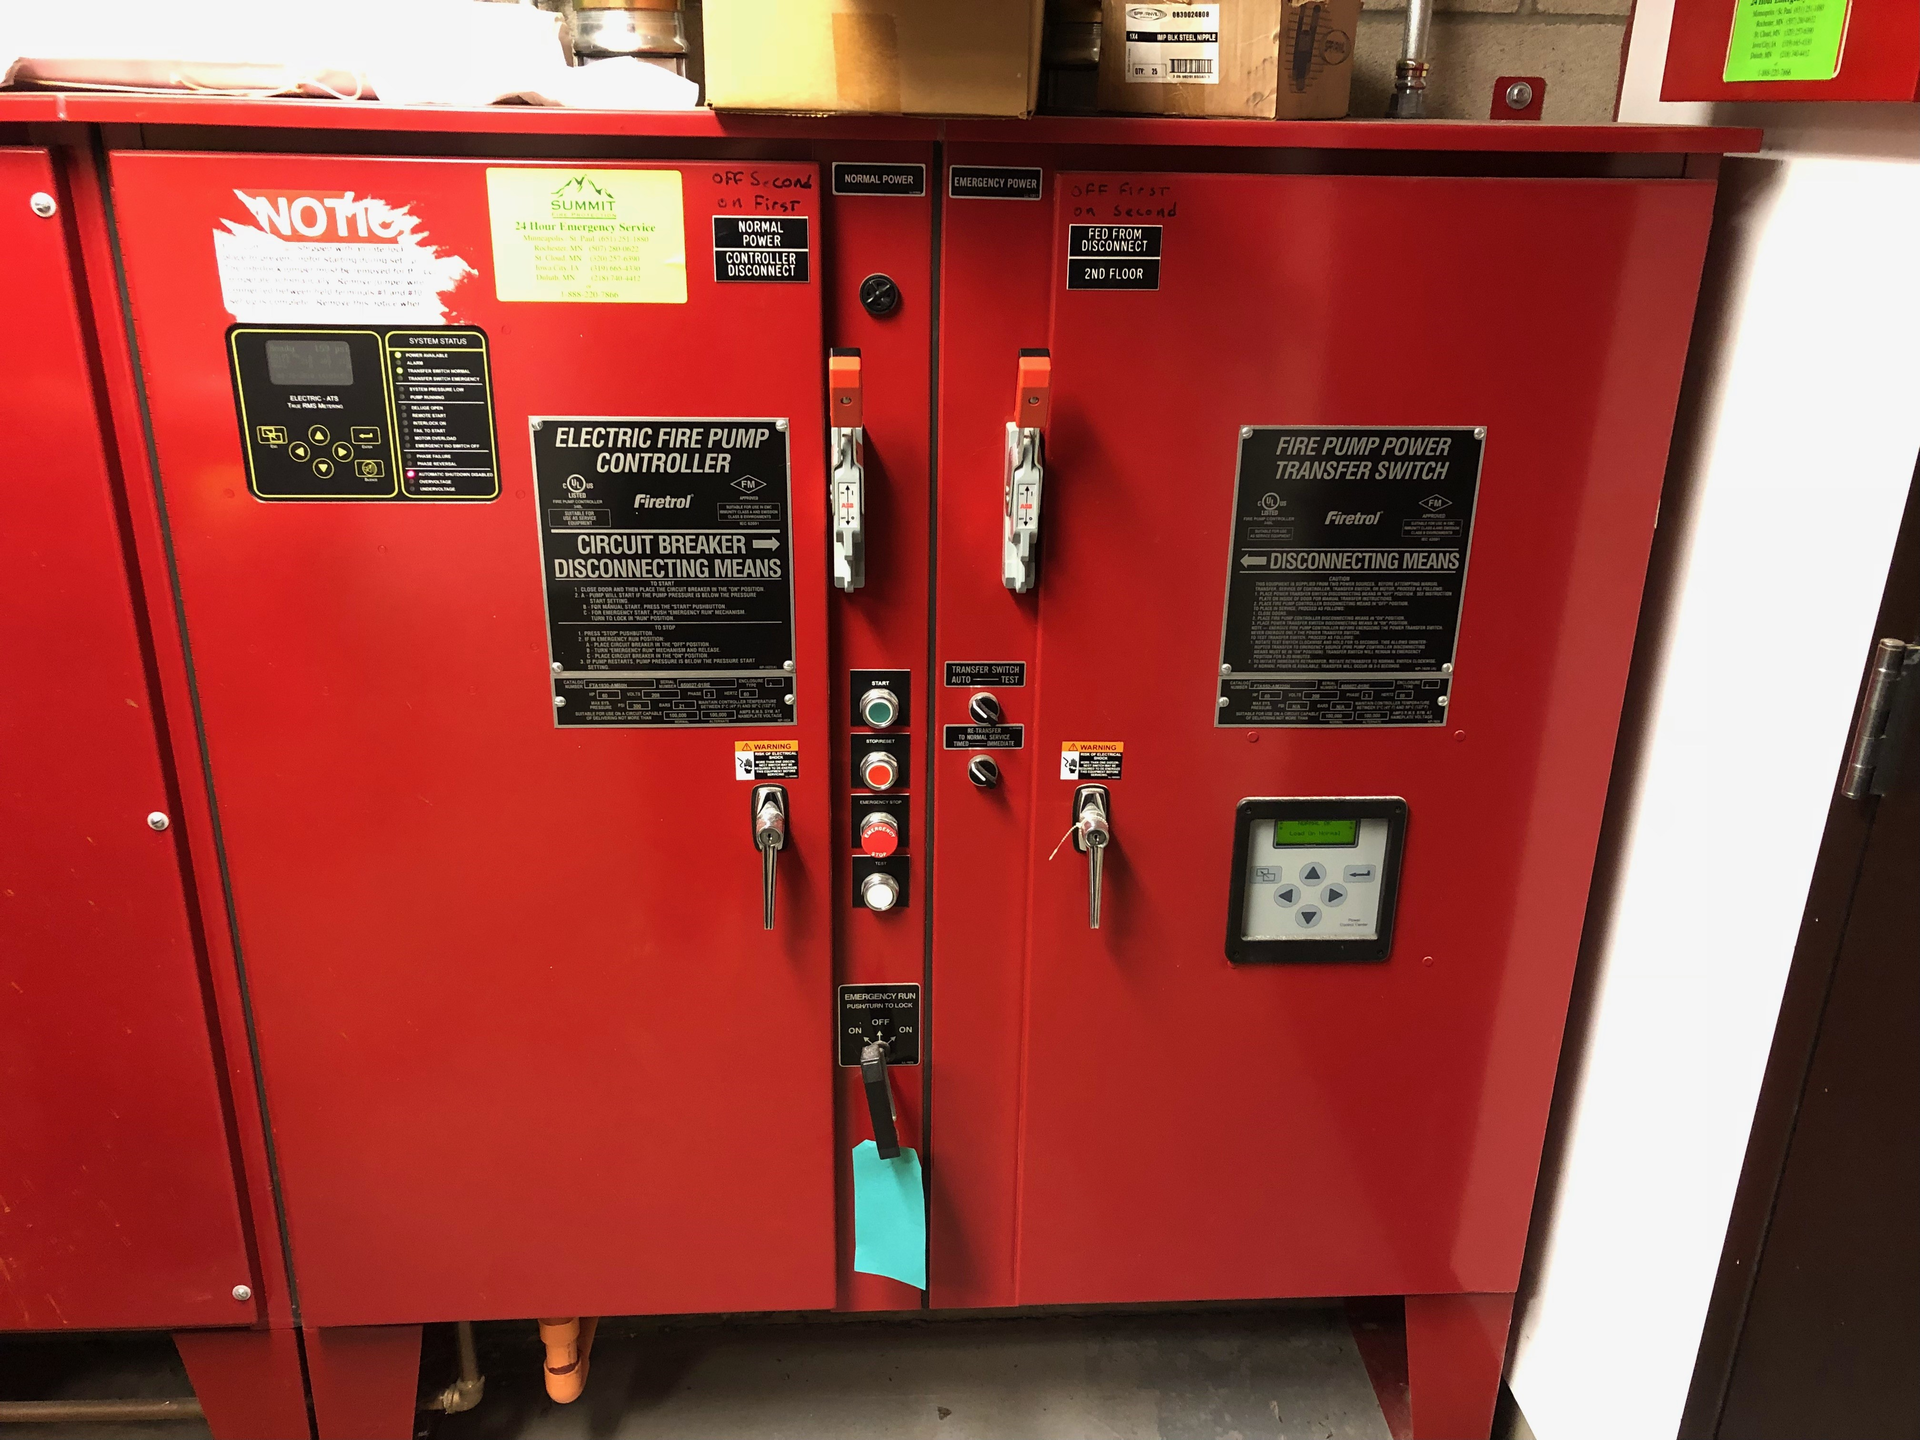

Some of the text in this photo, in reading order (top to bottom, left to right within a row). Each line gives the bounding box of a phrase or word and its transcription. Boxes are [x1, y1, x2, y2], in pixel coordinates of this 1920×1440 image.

[712, 171, 744, 185] OFF
[845, 174, 914, 184] NORMAL POWER
[954, 177, 1037, 189] EMERGENCY POWER
[551, 200, 616, 211] SUMMIT
[255, 195, 403, 239] NOTIC
[516, 221, 656, 234] 24 Hour Emergency Service
[738, 221, 784, 233] NORMAL
[1089, 228, 1142, 240] FED FROM
[743, 235, 781, 246] POWER
[1082, 240, 1148, 252] DISCONNECT
[726, 252, 796, 264] CONTROLLER
[728, 264, 795, 276] DISCONNECT
[1085, 268, 1144, 279] 2ND FLOOR
[555, 427, 770, 449] ELECTRIC FIRE PUMP
[1276, 437, 1452, 456] FIRE PUMP POWER
[596, 452, 732, 473] CONTROLLER
[1276, 461, 1450, 480] TRANSFER SWITCH
[634, 494, 692, 509] Firetrol
[1324, 511, 1382, 525] Firetrol
[578, 535, 746, 554] CIRCUIT BREAKER
[1270, 552, 1460, 569] DISCONNECTING MEANS
[554, 558, 782, 578] DISCONNECTING MEANS
[952, 666, 1019, 674] TRANSFER SWITCH
[864, 826, 895, 838] EMERGENCY
